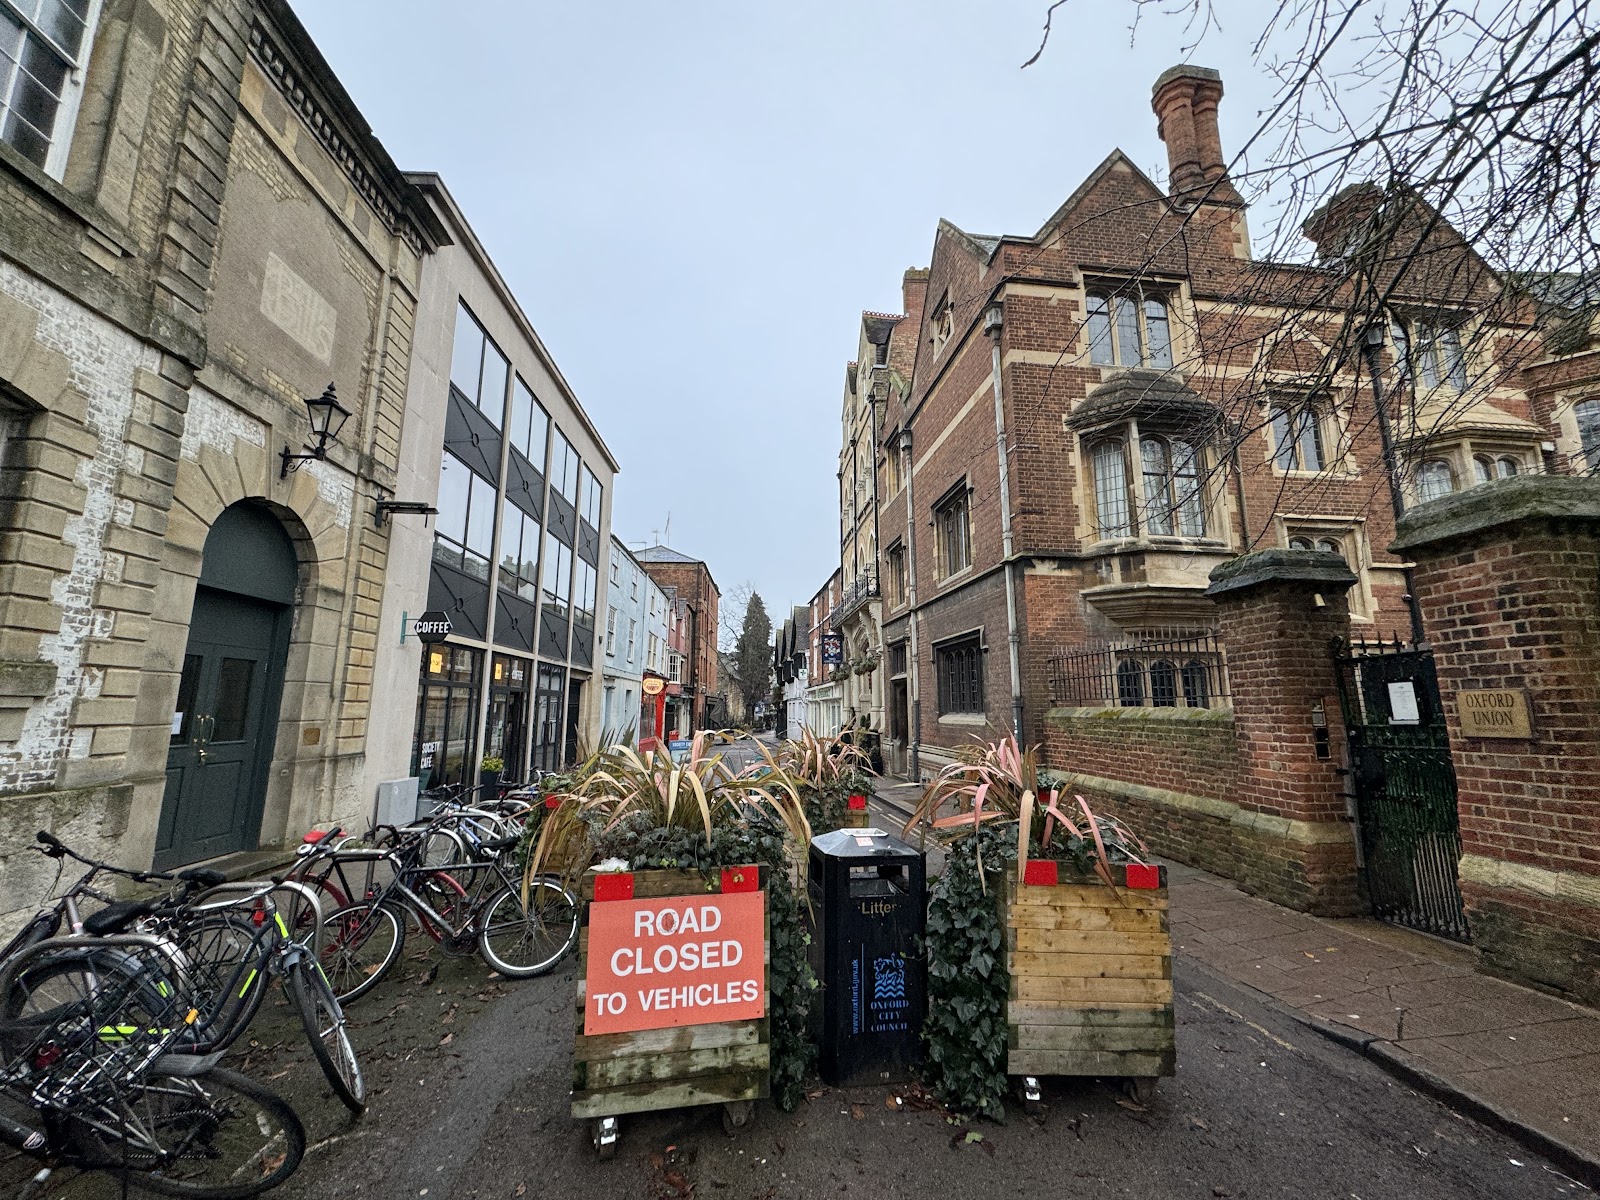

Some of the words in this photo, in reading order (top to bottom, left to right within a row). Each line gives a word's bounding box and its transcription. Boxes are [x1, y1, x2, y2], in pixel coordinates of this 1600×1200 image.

[416, 621, 449, 634] COFFEE
[1466, 693, 1515, 709] OXFORD
[1473, 710, 1514, 726] UNION
[421, 741, 441, 754] SOCIETY
[861, 901, 897, 915] Litter
[634, 906, 722, 938] ROAD
[610, 940, 743, 977] CLOSED
[592, 992, 627, 1016] TO
[638, 979, 759, 1012] VEHICLES
[851, 959, 860, 1035] www.oxford.gov.uk
[870, 999, 909, 1010] OXFORD
[878, 1011, 900, 1021] CITY
